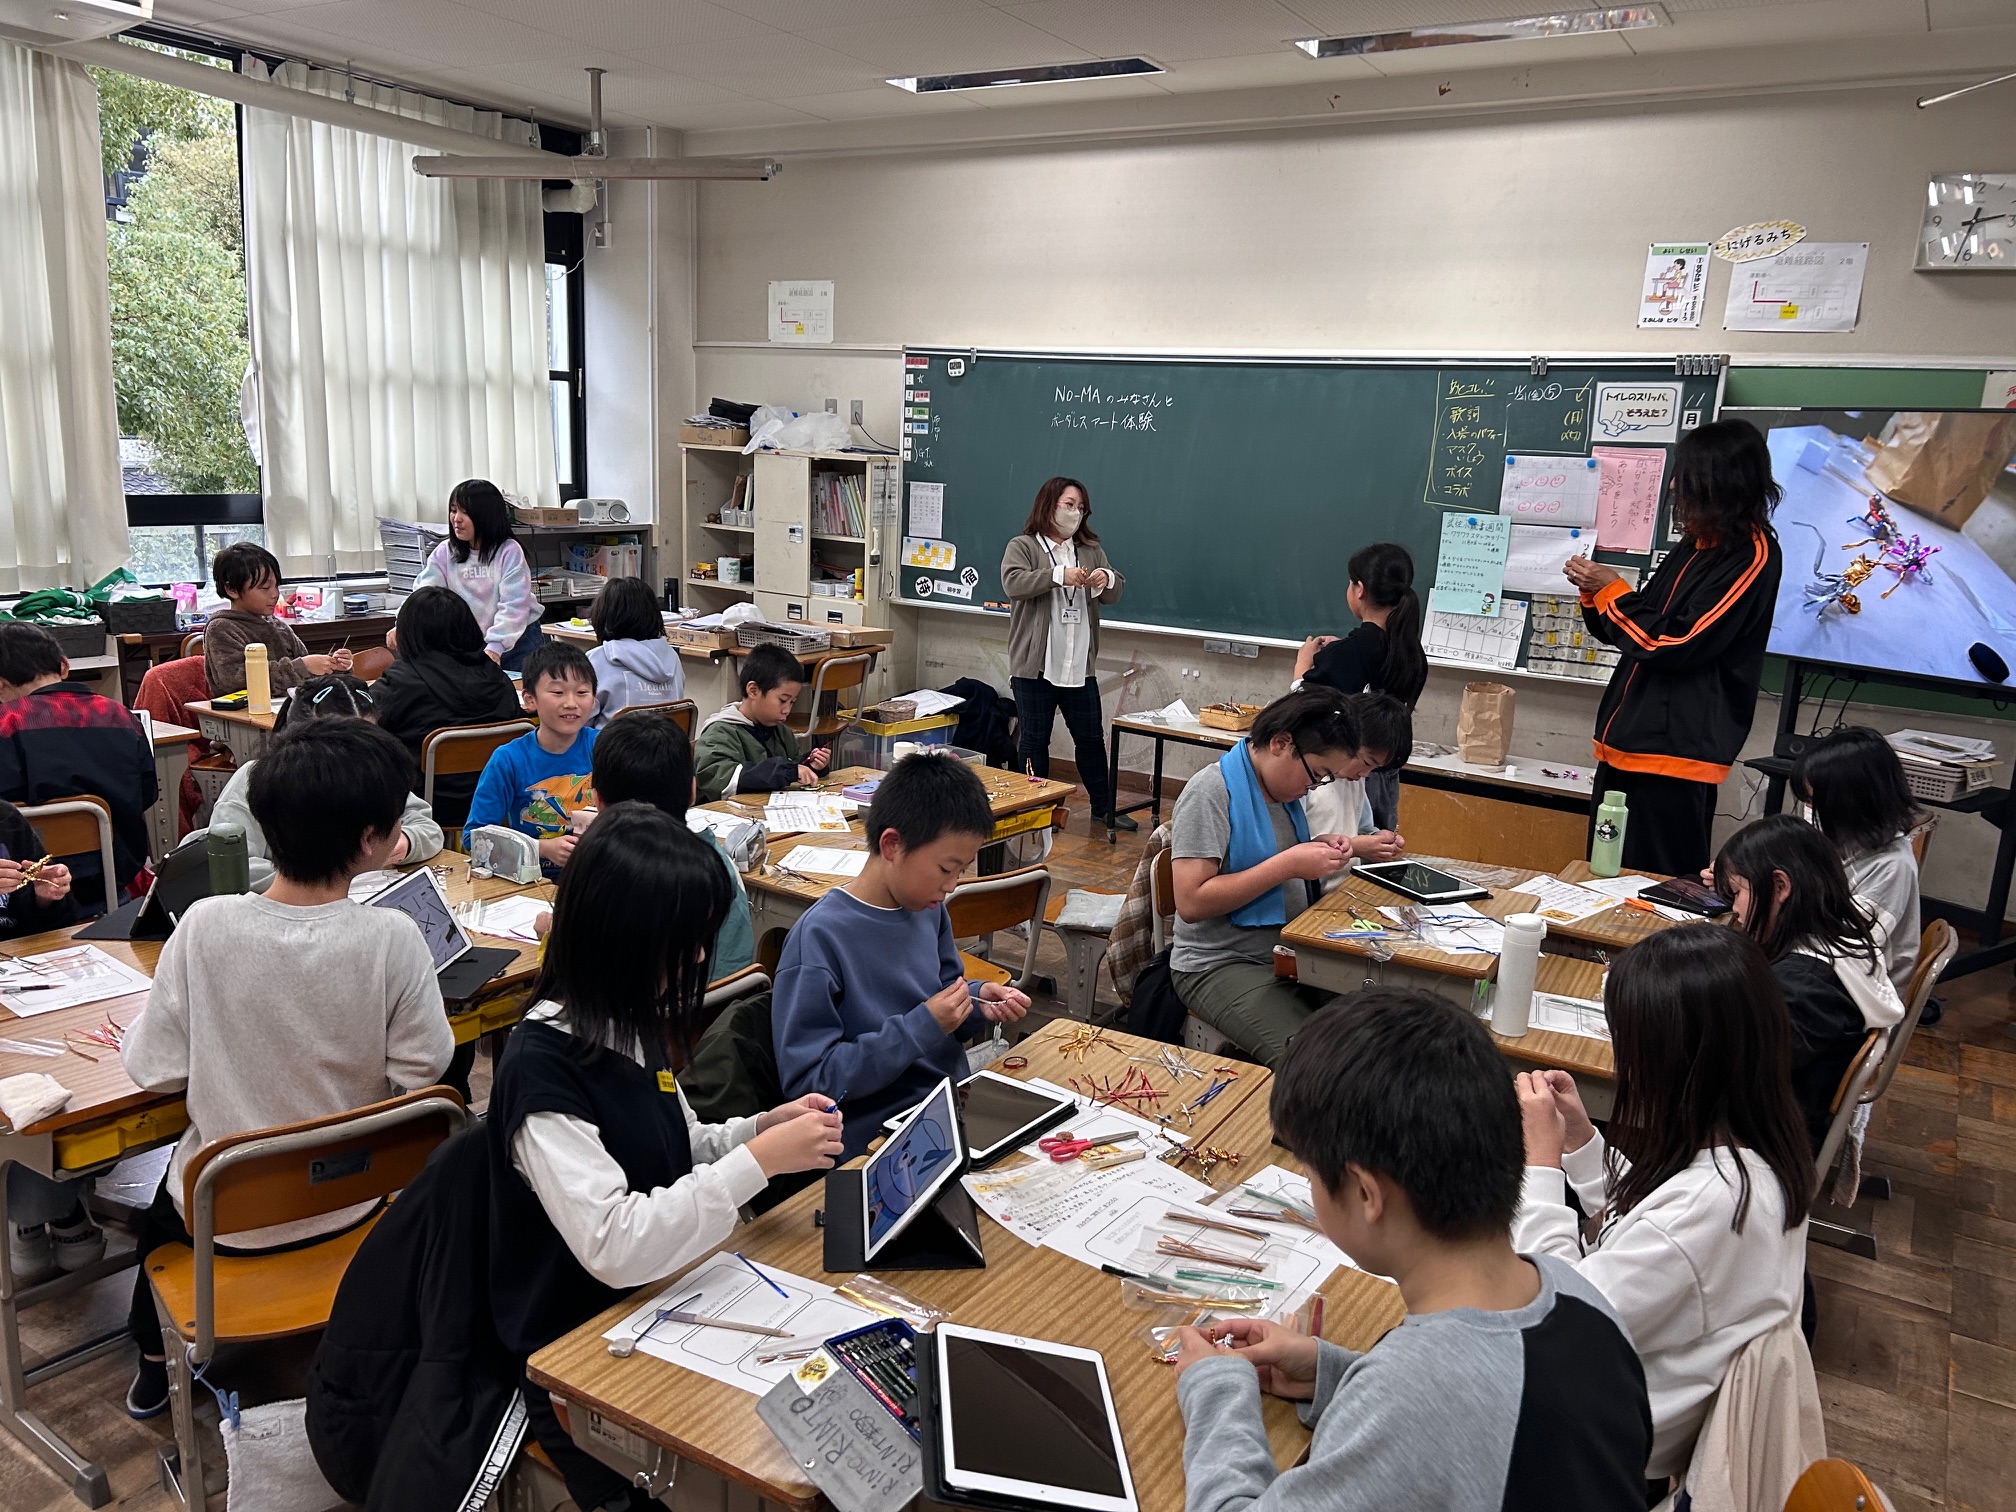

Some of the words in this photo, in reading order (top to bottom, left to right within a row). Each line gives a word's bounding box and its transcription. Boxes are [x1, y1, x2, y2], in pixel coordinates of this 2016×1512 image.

[1974, 181, 1986, 194] 12
[1932, 215, 1942, 227] 9
[2007, 214, 2016, 228] 3
[1728, 229, 1791, 251] にげるみち
[1963, 249, 1972, 261] 6
[1685, 412, 1697, 425] 月
[962, 568, 977, 586] 宿
[916, 578, 931, 594] 持
